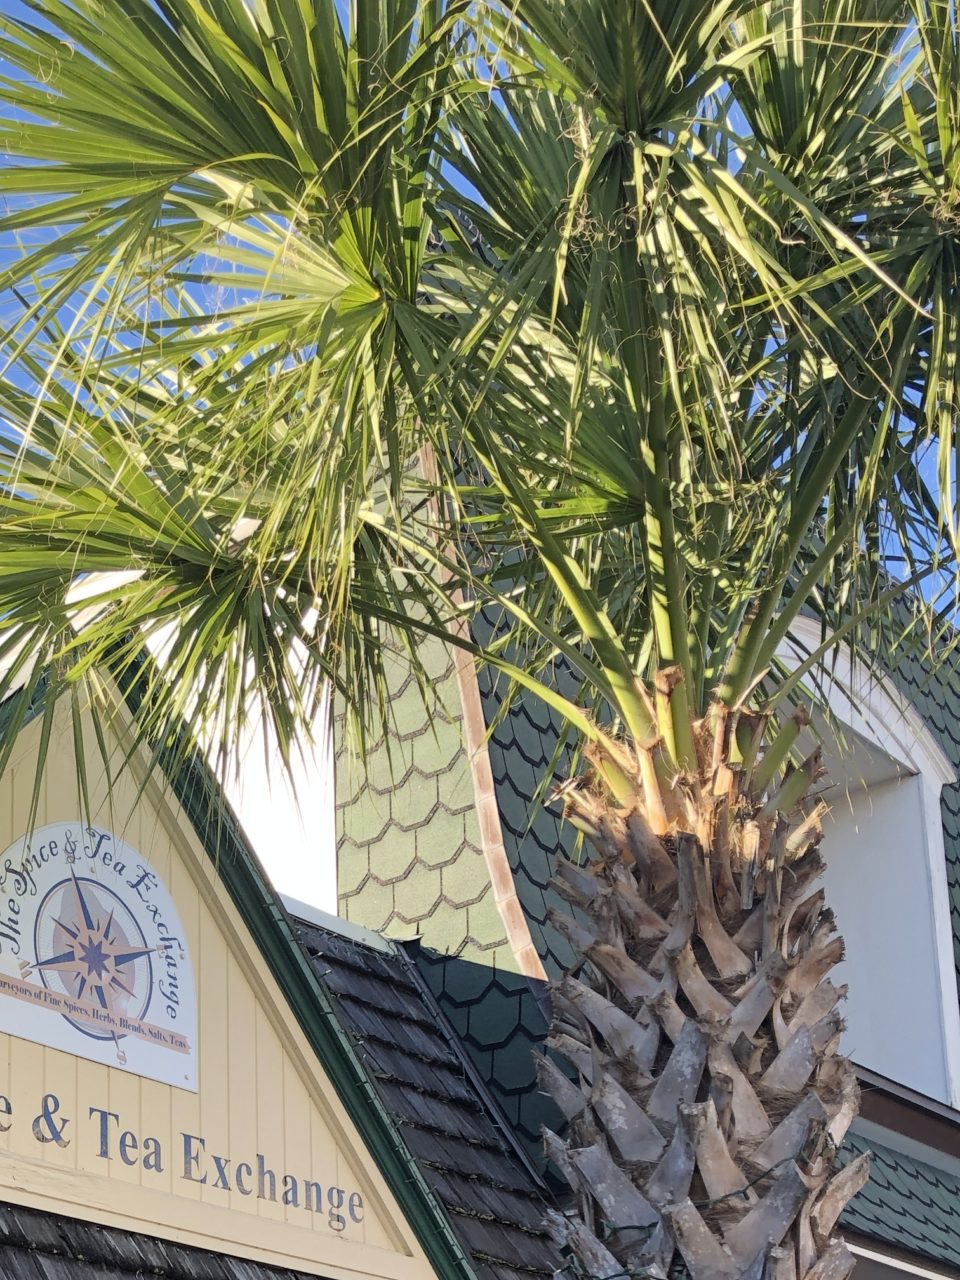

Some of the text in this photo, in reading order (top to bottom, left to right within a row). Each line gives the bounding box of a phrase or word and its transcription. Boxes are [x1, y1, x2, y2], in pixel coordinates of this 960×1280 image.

[84, 827, 127, 876] Tea
[126, 863, 184, 1020] Exchange
[33, 989, 44, 1001] of
[43, 992, 62, 1007] Fine
[168, 1034, 187, 1050] Teas
[32, 1094, 71, 1148] &
[89, 1106, 164, 1173] Tea
[180, 1132, 365, 1232] Exchange
